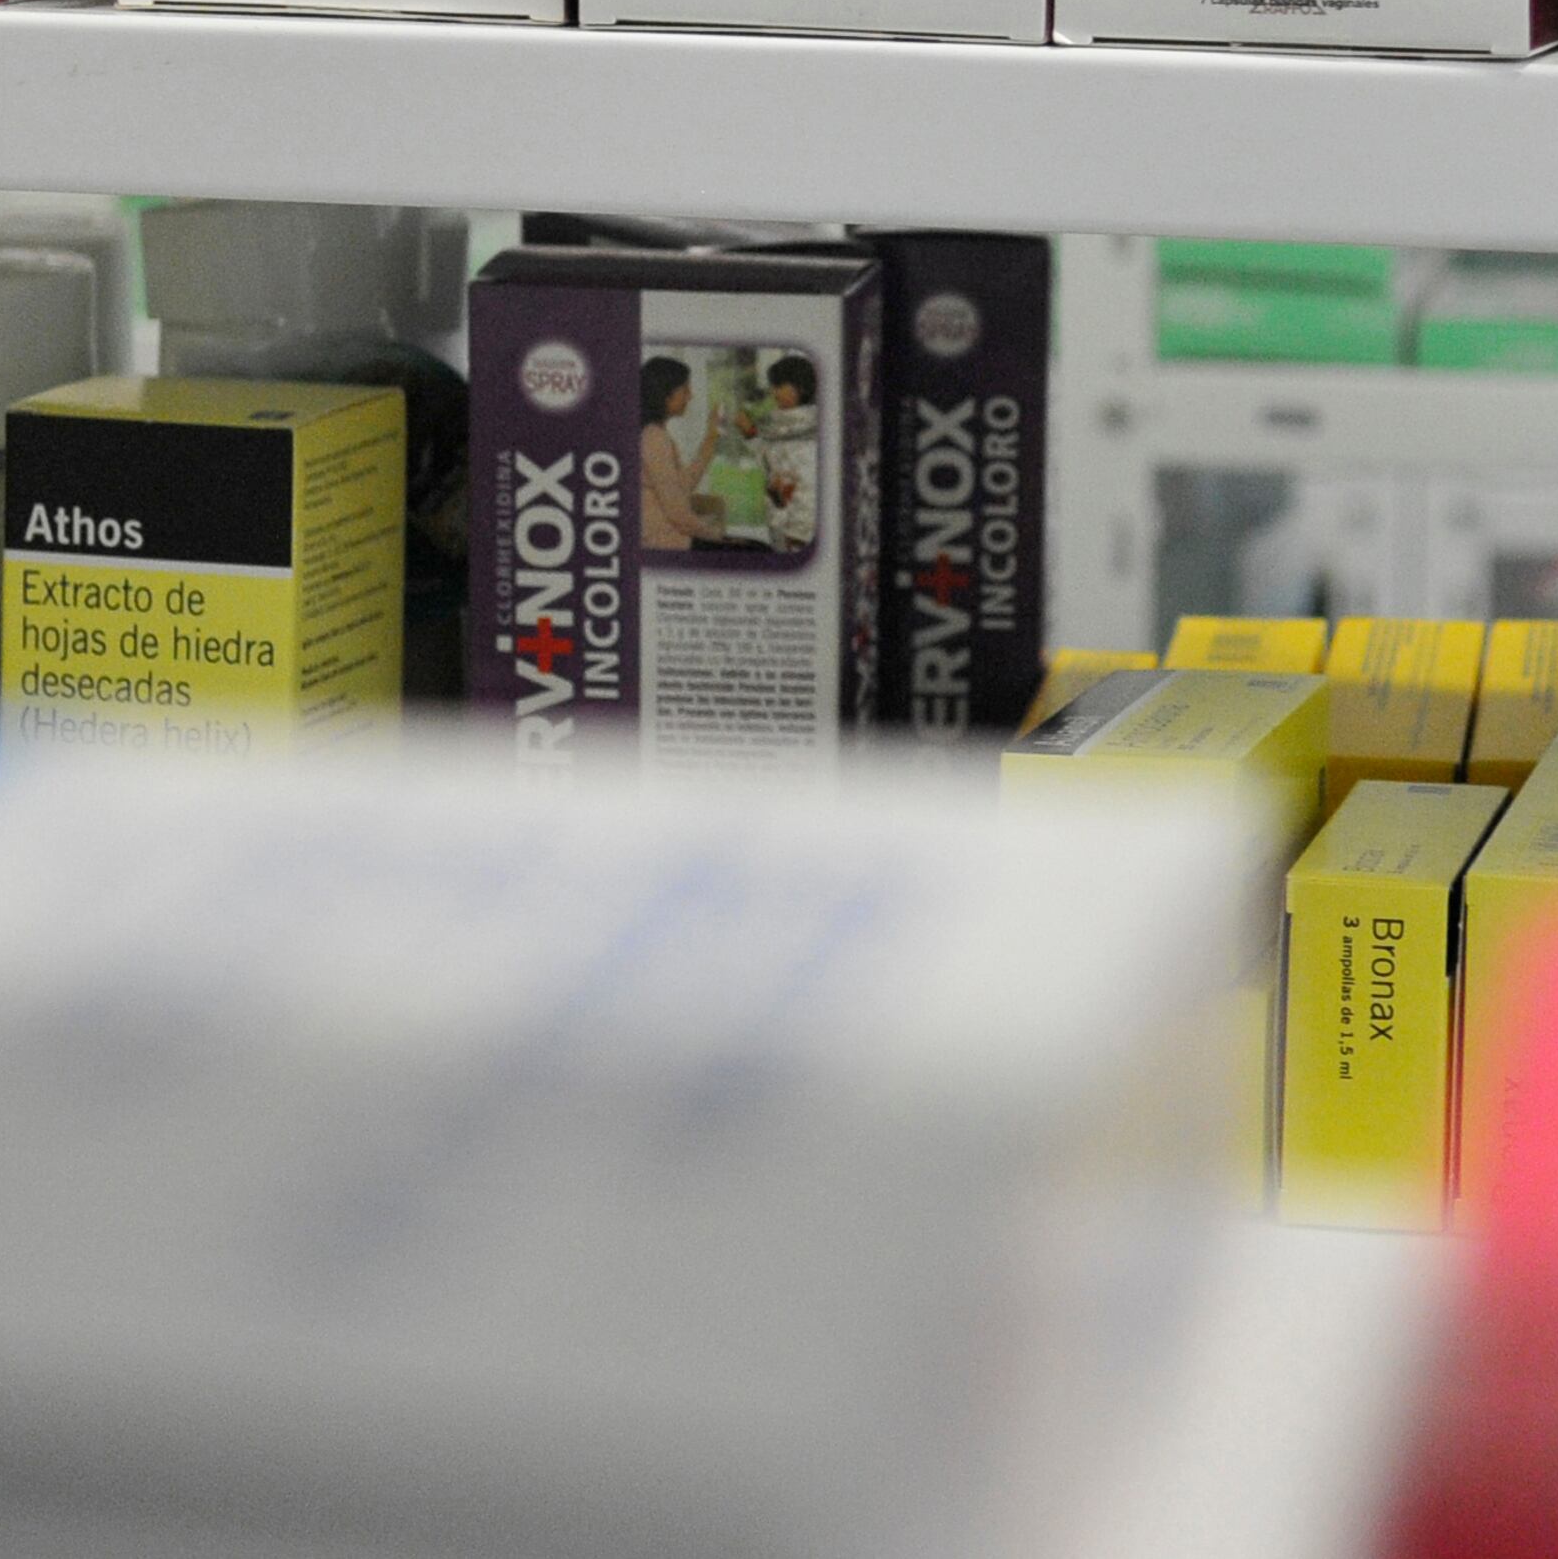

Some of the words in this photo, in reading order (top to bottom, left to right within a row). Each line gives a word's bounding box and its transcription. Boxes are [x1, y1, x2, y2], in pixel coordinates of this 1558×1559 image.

[25, 503, 143, 550] Athos
[981, 395, 1020, 630] INCOLORO
[22, 570, 153, 614] Extracto
[166, 581, 205, 616] de
[584, 451, 621, 700] INCOLORO
[22, 617, 107, 660] hojas
[120, 626, 159, 660] de
[172, 627, 275, 667] hiedra
[21, 664, 191, 707] desecadas
[1342, 916, 1360, 929] 3
[1339, 936, 1355, 1003] ampollas
[1368, 916, 1405, 1043] Bronax
[1340, 1008, 1355, 1026] de
[1339, 1061, 1354, 1080] ml
